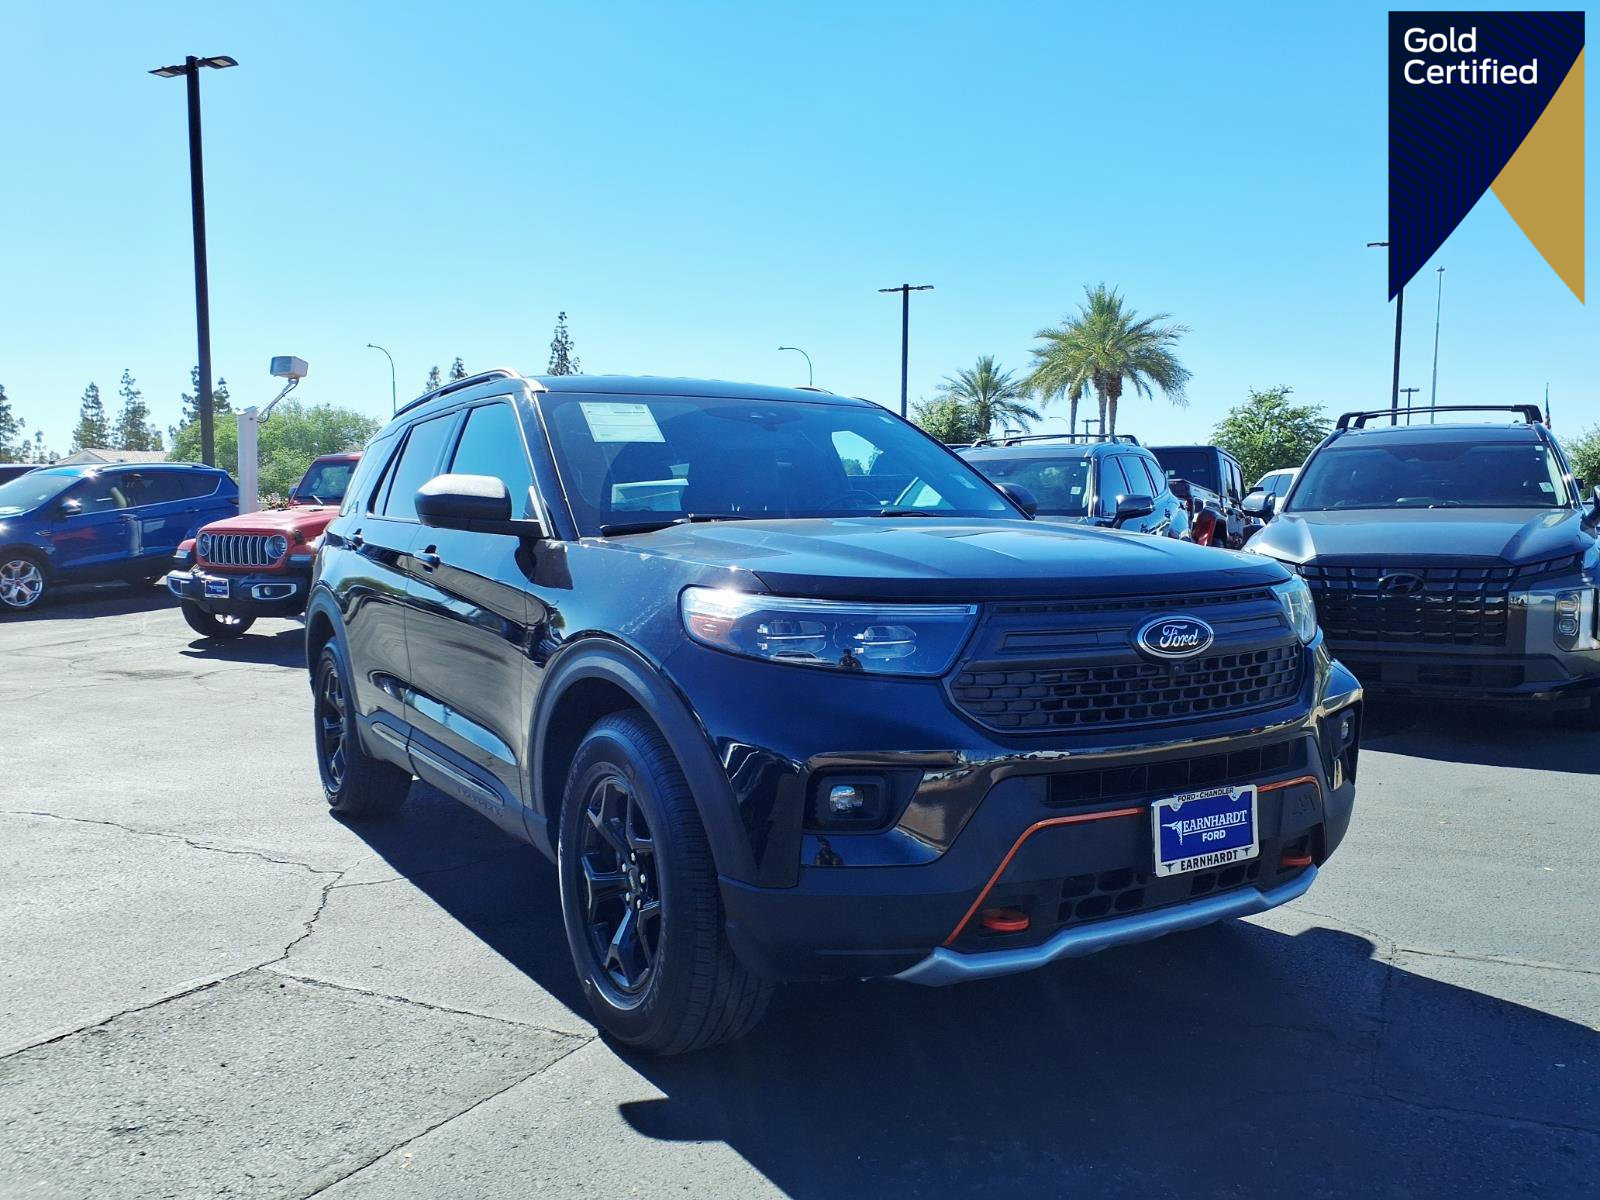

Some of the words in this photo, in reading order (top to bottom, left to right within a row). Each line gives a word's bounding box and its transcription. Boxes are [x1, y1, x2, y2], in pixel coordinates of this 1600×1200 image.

[1160, 624, 1199, 648] Ford
[1182, 809, 1248, 833] EARNHARDT
[1202, 829, 1226, 843] FORD
[1180, 849, 1239, 872] EARNHARDT
